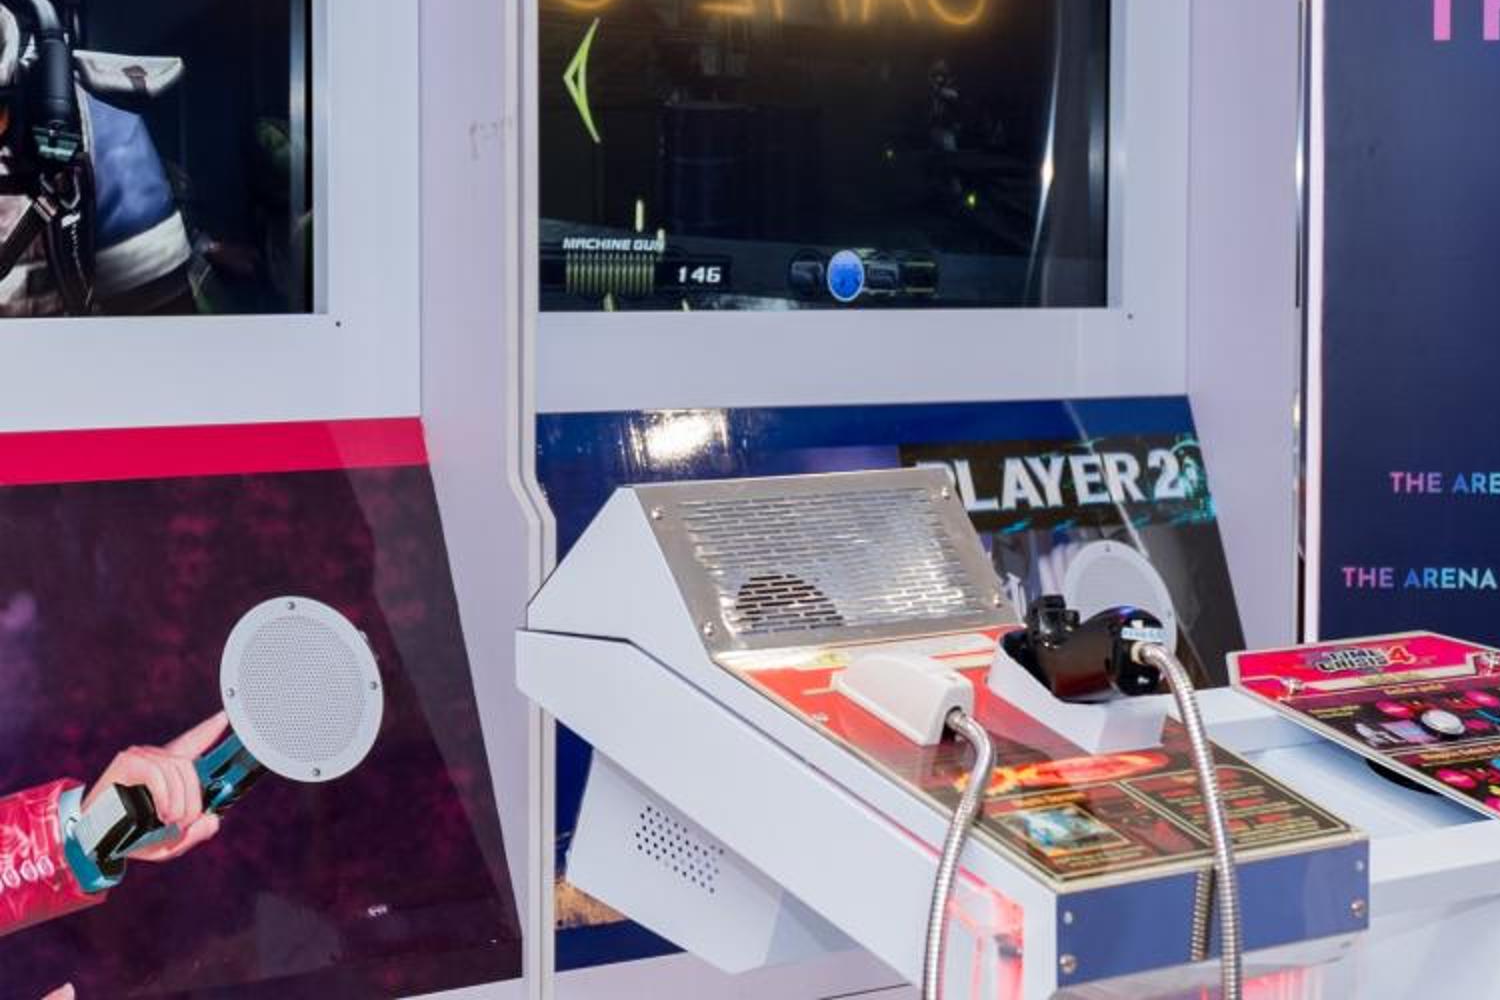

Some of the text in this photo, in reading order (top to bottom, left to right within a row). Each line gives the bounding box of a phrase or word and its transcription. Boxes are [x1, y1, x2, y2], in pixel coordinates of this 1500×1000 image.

[562, 237, 630, 250] MACHINE
[677, 266, 721, 283] 146
[1147, 448, 1186, 500] 2
[1390, 471, 1443, 494] THE
[1343, 567, 1499, 590] THE ARENA
